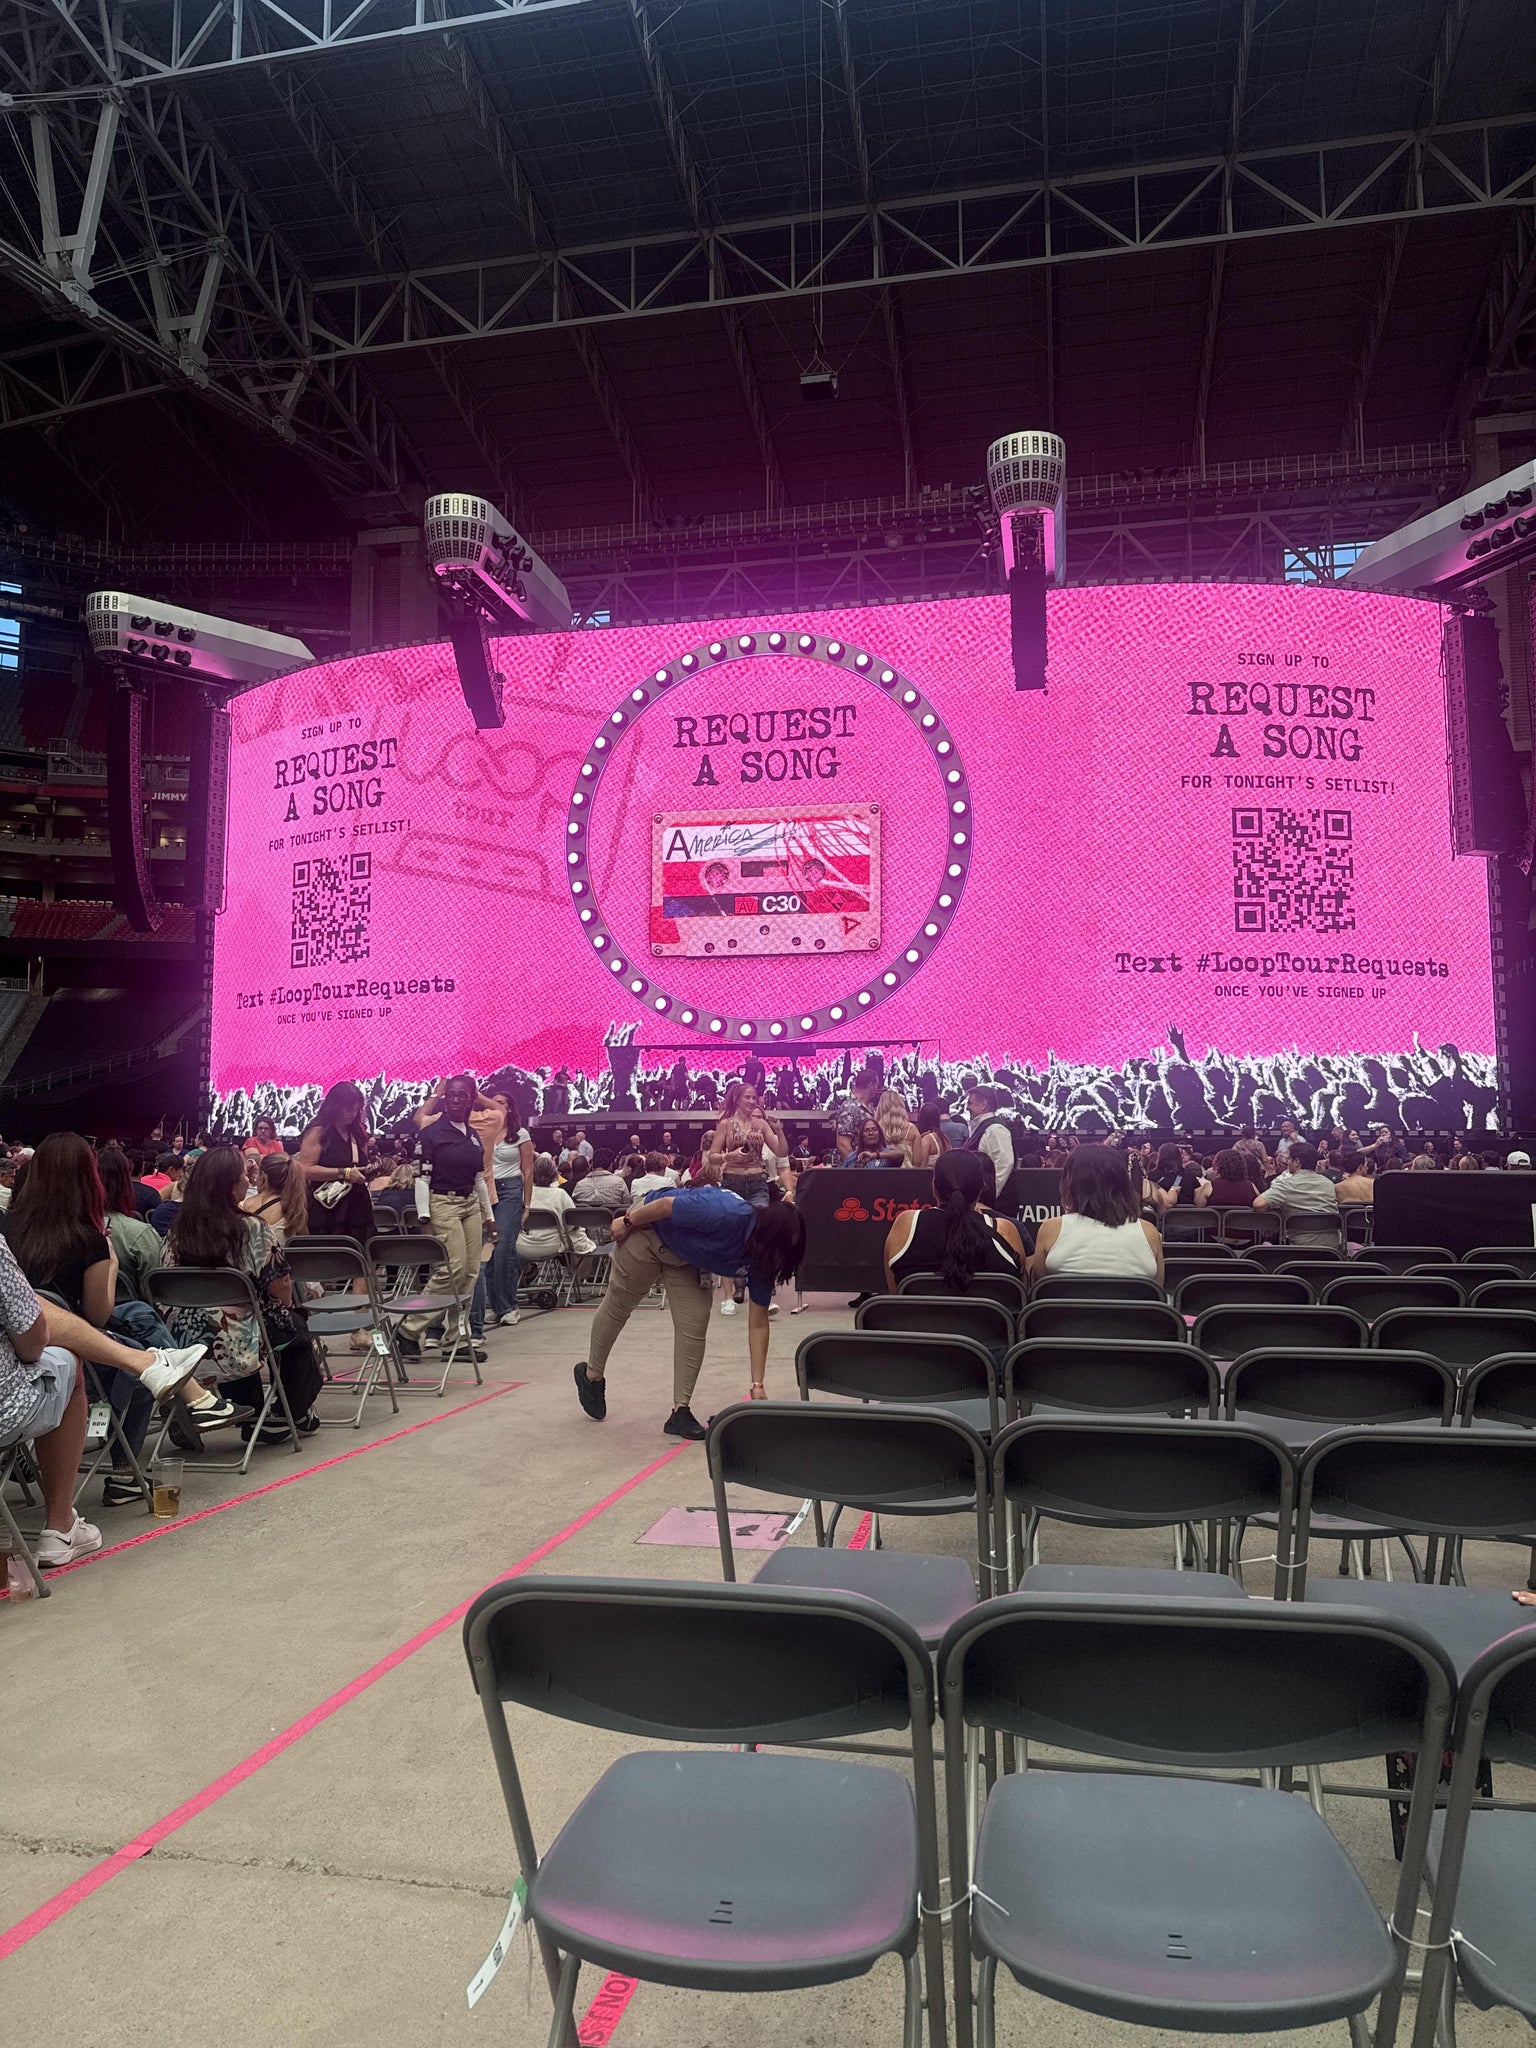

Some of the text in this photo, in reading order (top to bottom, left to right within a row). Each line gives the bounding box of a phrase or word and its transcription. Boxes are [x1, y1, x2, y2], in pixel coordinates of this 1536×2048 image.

[1238, 653, 1329, 668] SIGN UP TO
[1187, 682, 1375, 722] REQUEST
[302, 717, 361, 739] SIGN UP TO
[673, 705, 856, 748] REQUEST
[1210, 724, 1364, 761] A SONG
[274, 736, 397, 790] REQUEST
[692, 746, 841, 786] A SONG
[151, 792, 188, 801] JIMMY
[284, 776, 385, 822] A SONG
[1182, 775, 1394, 795] FOR TONIGHT'S SETLIST!
[269, 820, 410, 851] FOR TONIGHT'S SETLIST!
[762, 894, 801, 913] C30
[1115, 952, 1449, 979] Text #LoopTourRequests
[237, 975, 455, 1009] Text #LoopTourRequests
[1215, 986, 1386, 998] ONCE YOU'VE SIGNED UP
[278, 1008, 391, 1024] ONCE YOU'VE SIGNED UP
